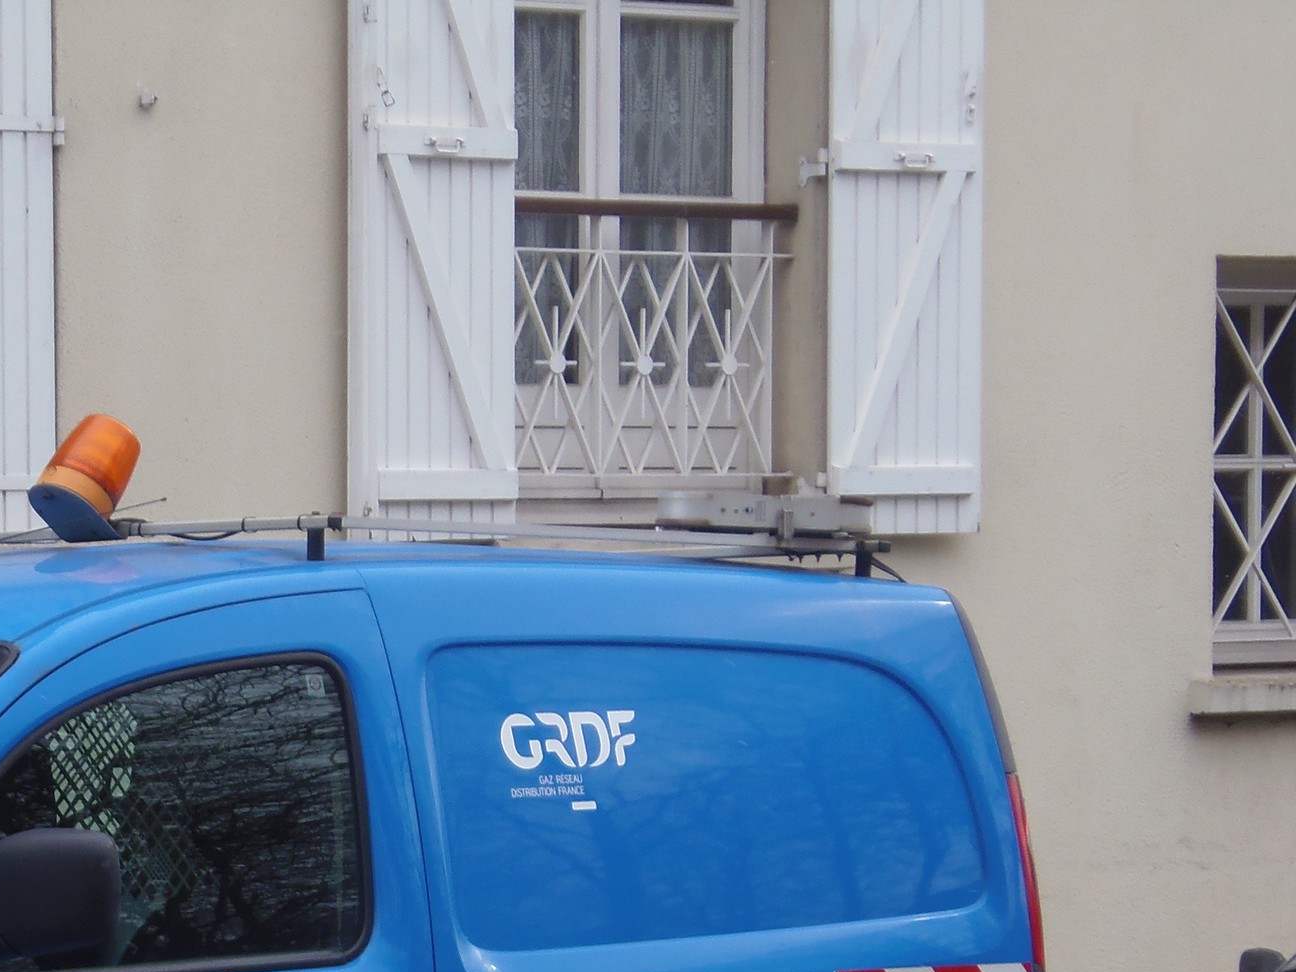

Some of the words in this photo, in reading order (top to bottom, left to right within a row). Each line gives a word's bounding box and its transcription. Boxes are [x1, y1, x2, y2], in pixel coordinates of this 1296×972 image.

[500, 710, 636, 770] GRDF
[539, 775, 554, 785] GAZ
[511, 786, 556, 798] DISTRIBUTION
[558, 785, 585, 796] FRANCE
